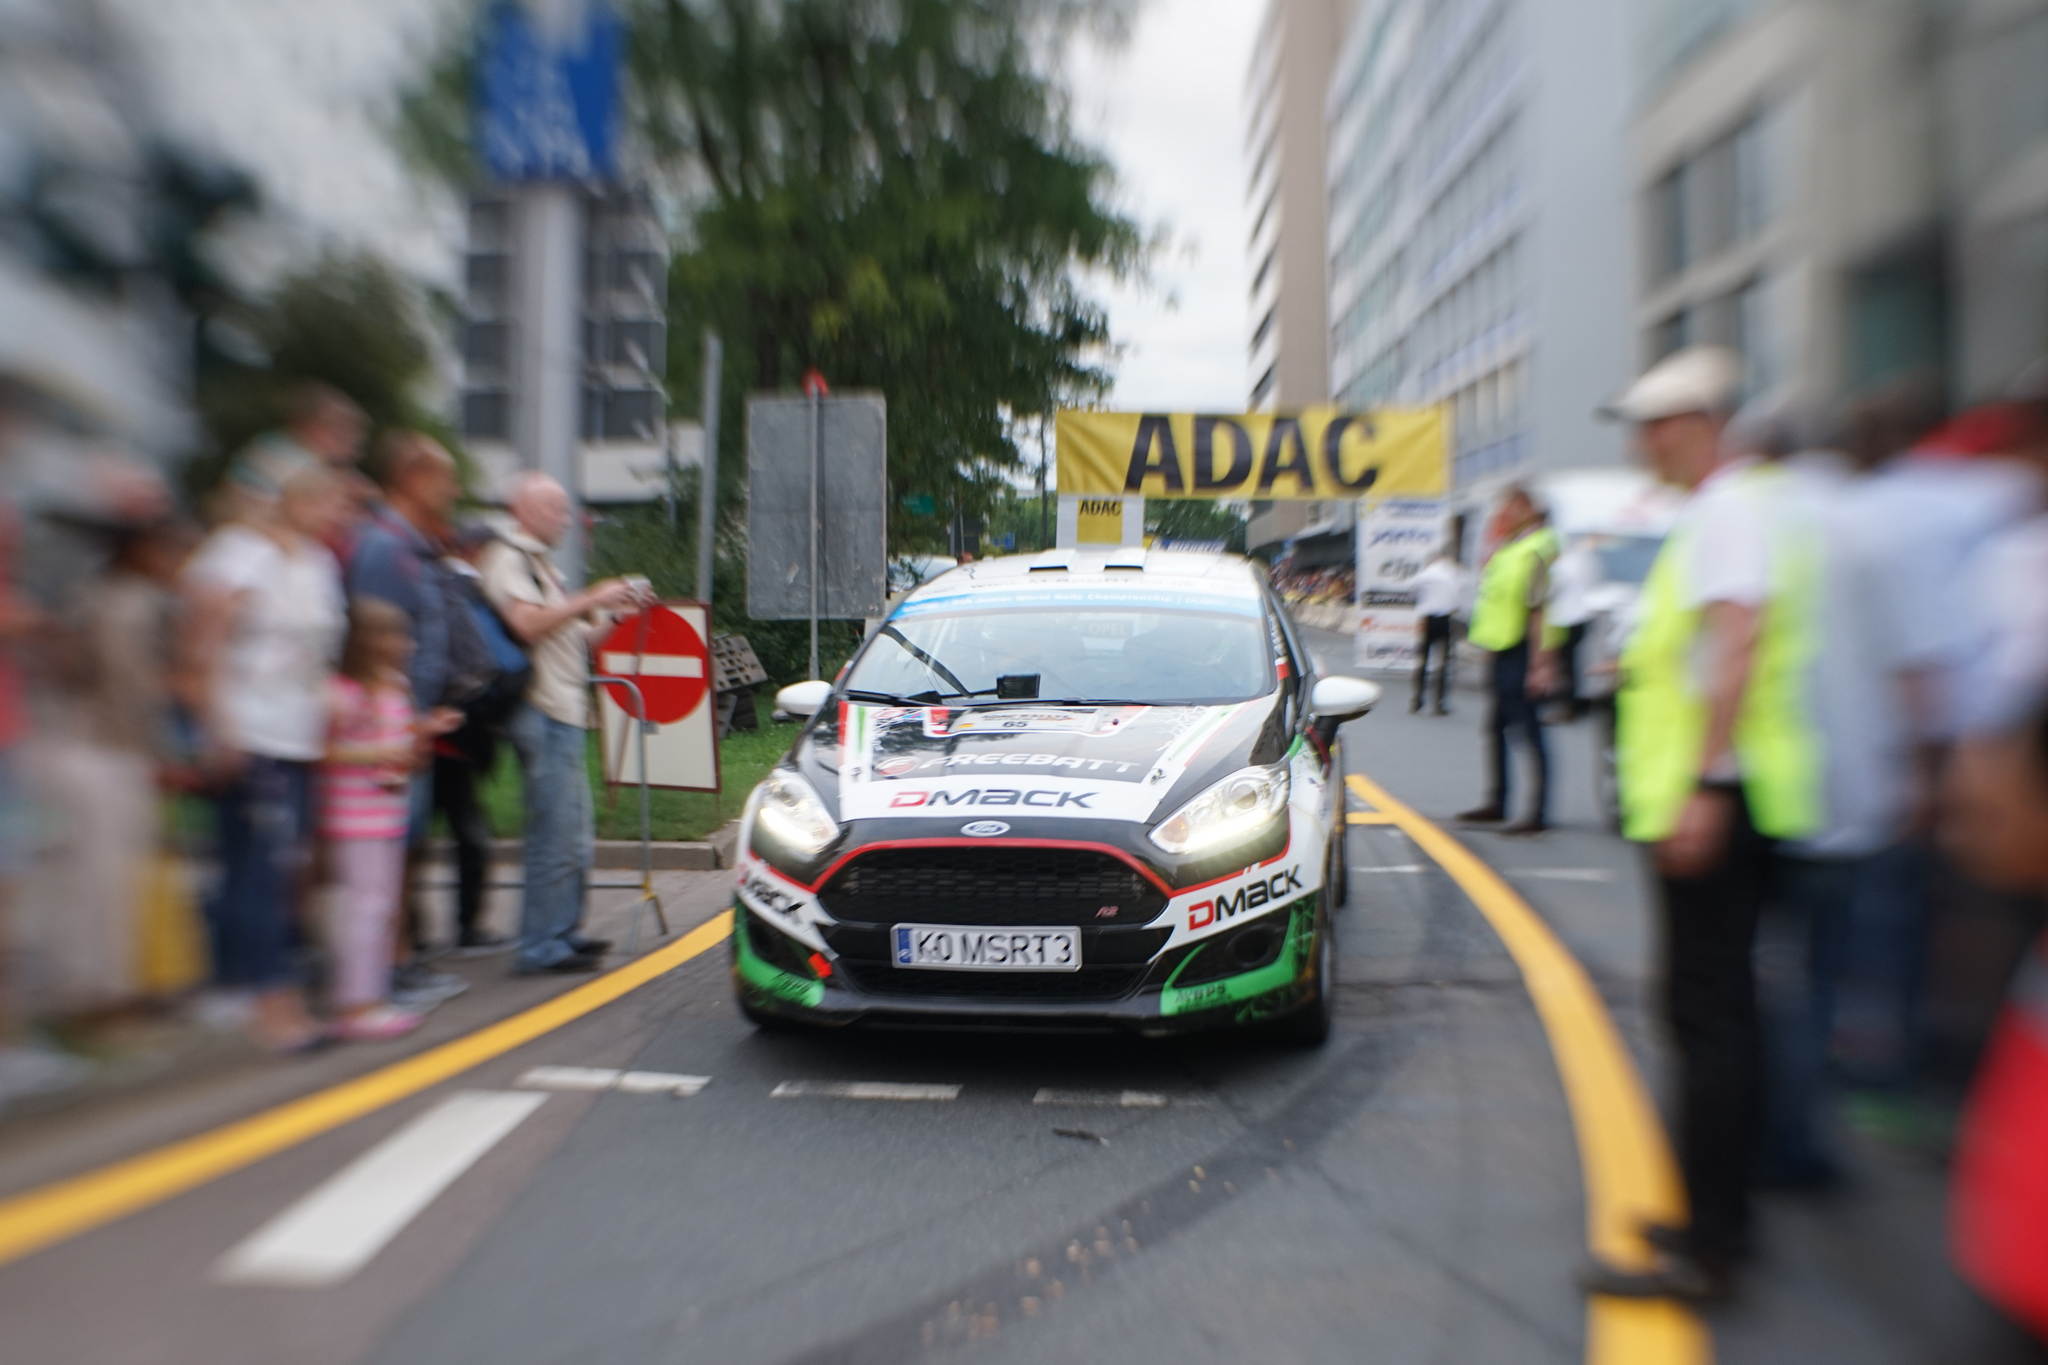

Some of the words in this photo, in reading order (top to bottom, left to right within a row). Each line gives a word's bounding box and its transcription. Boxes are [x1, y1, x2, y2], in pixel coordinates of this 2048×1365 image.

[1123, 413, 1380, 496] ADAC
[1079, 500, 1121, 516] ADAC
[918, 752, 1144, 774] FREEBATT
[888, 788, 1100, 810] DMACK
[1187, 863, 1303, 931] DMACK
[960, 932, 1072, 964] MSRT3
